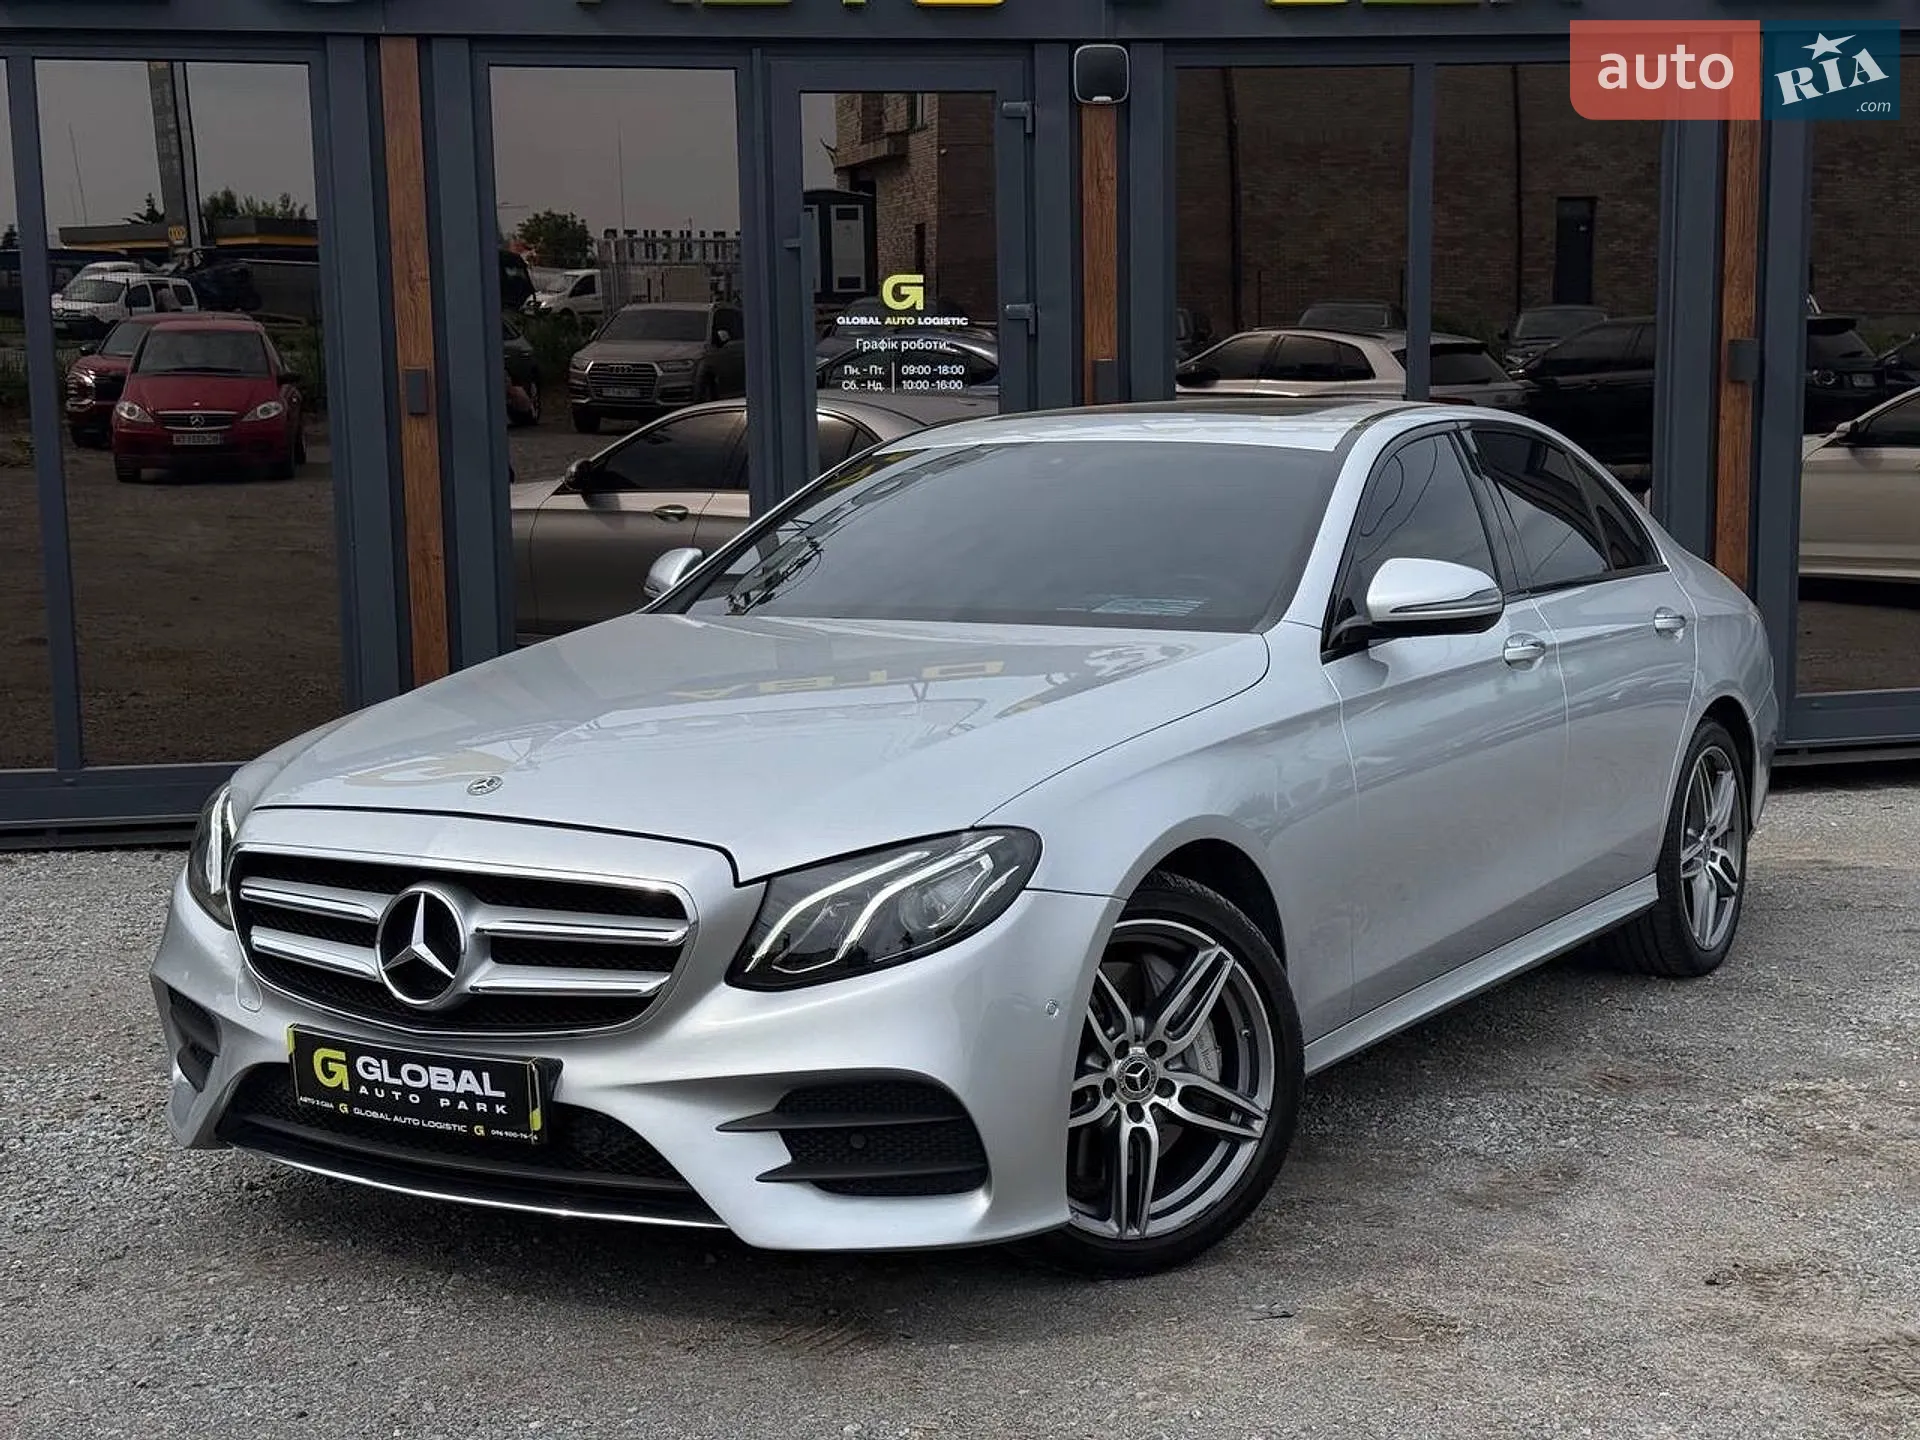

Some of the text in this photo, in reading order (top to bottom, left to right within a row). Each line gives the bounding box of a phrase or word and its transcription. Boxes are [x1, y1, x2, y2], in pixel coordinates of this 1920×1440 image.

[836, 316, 968, 326] GLOBAL AUTO LOGISTIC
[856, 338, 898, 351] Графік
[355, 1055, 506, 1098] GLOBAL
[359, 1085, 508, 1115] AUTO PARK
[353, 1107, 468, 1133] GLOBAL AUTO LOGISTIC
